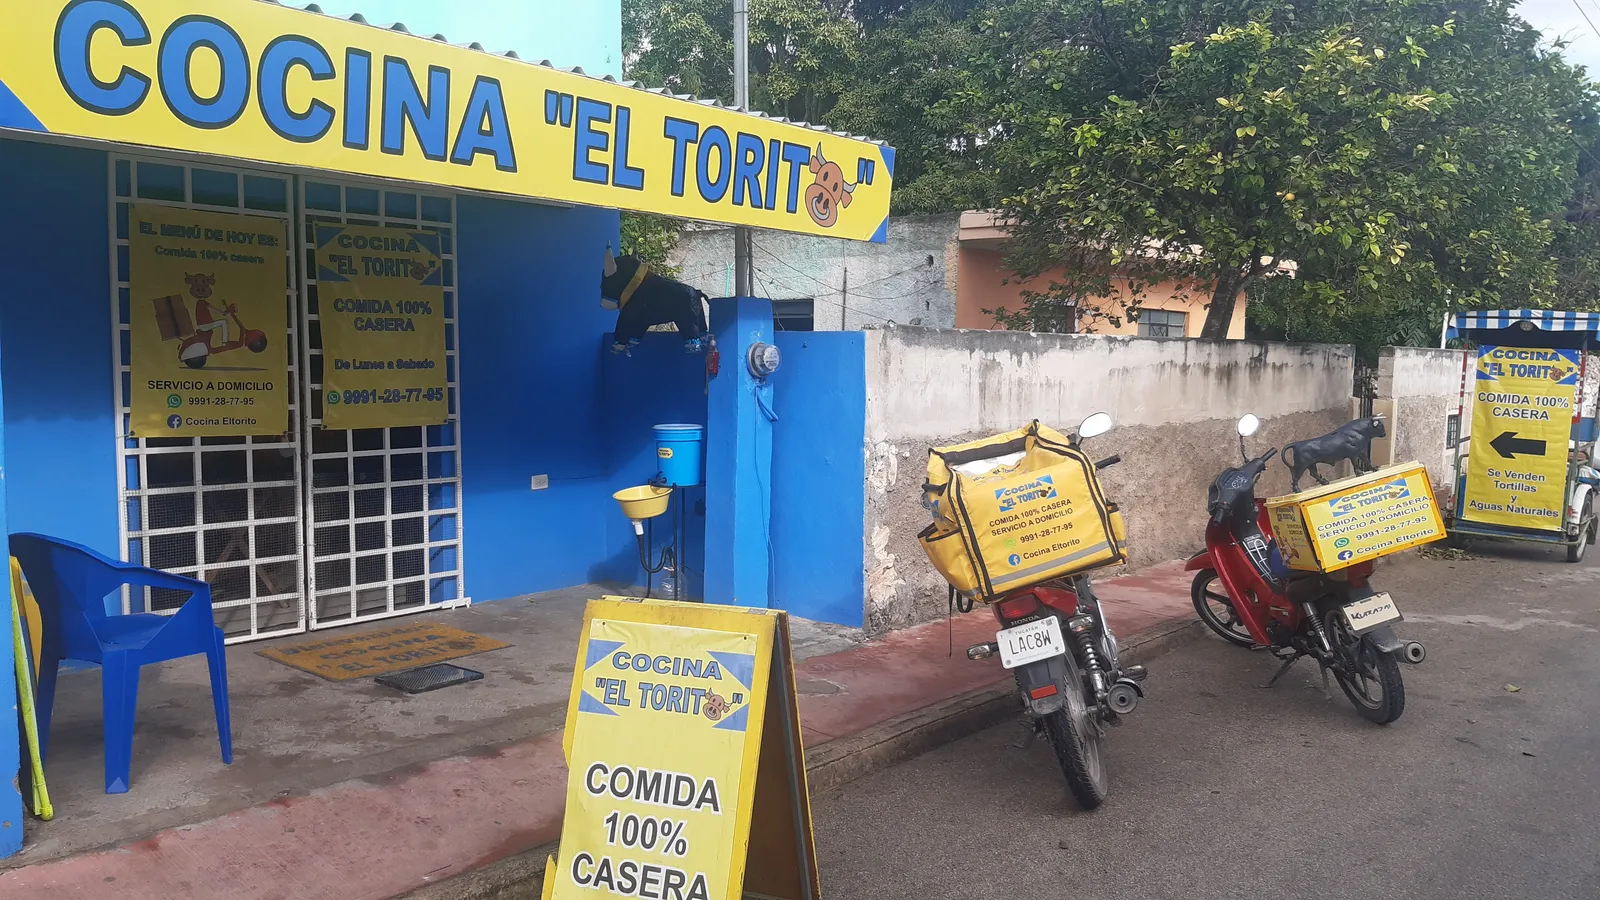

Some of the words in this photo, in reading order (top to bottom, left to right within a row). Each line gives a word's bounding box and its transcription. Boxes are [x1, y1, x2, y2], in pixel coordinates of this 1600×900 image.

[54, 0, 517, 173] COCINA
[139, 221, 157, 236] EL
[160, 223, 201, 240] MENÚ
[205, 229, 224, 242] DE
[227, 230, 255, 245] HOY
[337, 234, 420, 253] COCINA
[155, 245, 197, 259] Comida
[200, 248, 228, 262] 100%
[230, 253, 265, 264] casera
[333, 298, 394, 315] COMIDA
[396, 300, 433, 316] 100%
[353, 317, 416, 332] CASERA
[334, 359, 351, 371] De
[352, 359, 385, 371] Lunes
[387, 361, 395, 370] a
[1493, 349, 1561, 362] COCINA
[148, 380, 204, 391] SERVICIO
[206, 381, 215, 391] A
[217, 381, 274, 392] DOMICILIO
[188, 396, 255, 407] 9991-28-77-95
[343, 387, 444, 405] 9991-28-77-95
[1478, 392, 1531, 406] COMIDA
[1535, 396, 1570, 409] 100%
[185, 417, 220, 427] Cocina
[222, 416, 257, 427] Eltorito
[1492, 407, 1550, 421] CASERA
[1487, 468, 1501, 478] Se
[1504, 470, 1546, 482] Venden
[1004, 481, 1043, 496] COCINA
[1341, 484, 1393, 503] COCINA
[1494, 480, 1538, 493] Tortillas
[1469, 499, 1504, 513] Aguas
[1506, 504, 1560, 518] Naturales
[1510, 495, 1517, 504] y
[989, 514, 1020, 527] COMIDA
[1021, 508, 1040, 519] 100%
[1041, 498, 1072, 513] CASERA
[991, 521, 1027, 536] SERVICIO
[1028, 519, 1035, 527] A
[1035, 507, 1074, 524] DOMICILIO
[1317, 516, 1358, 532] COMIDA
[1360, 508, 1386, 519] 100%
[1388, 495, 1429, 511] CASERA
[1319, 521, 1367, 540] SERVICIO
[1378, 503, 1430, 522] DOMICILIO
[1020, 522, 1074, 543] 9991-28-77-95
[1356, 515, 1427, 541] 9991-28-77-95
[1023, 548, 1051, 560] Cocina
[1051, 538, 1081, 552] Eltorito
[1356, 540, 1393, 554] Cocina
[1395, 528, 1434, 543] Eltorito
[1010, 615, 1041, 626] HONDA
[1009, 629, 1052, 655] LAC8W
[612, 651, 722, 680] COCINA
[586, 763, 721, 812] COMIDA
[604, 811, 688, 857] 100%
[572, 853, 712, 900] CASERA
